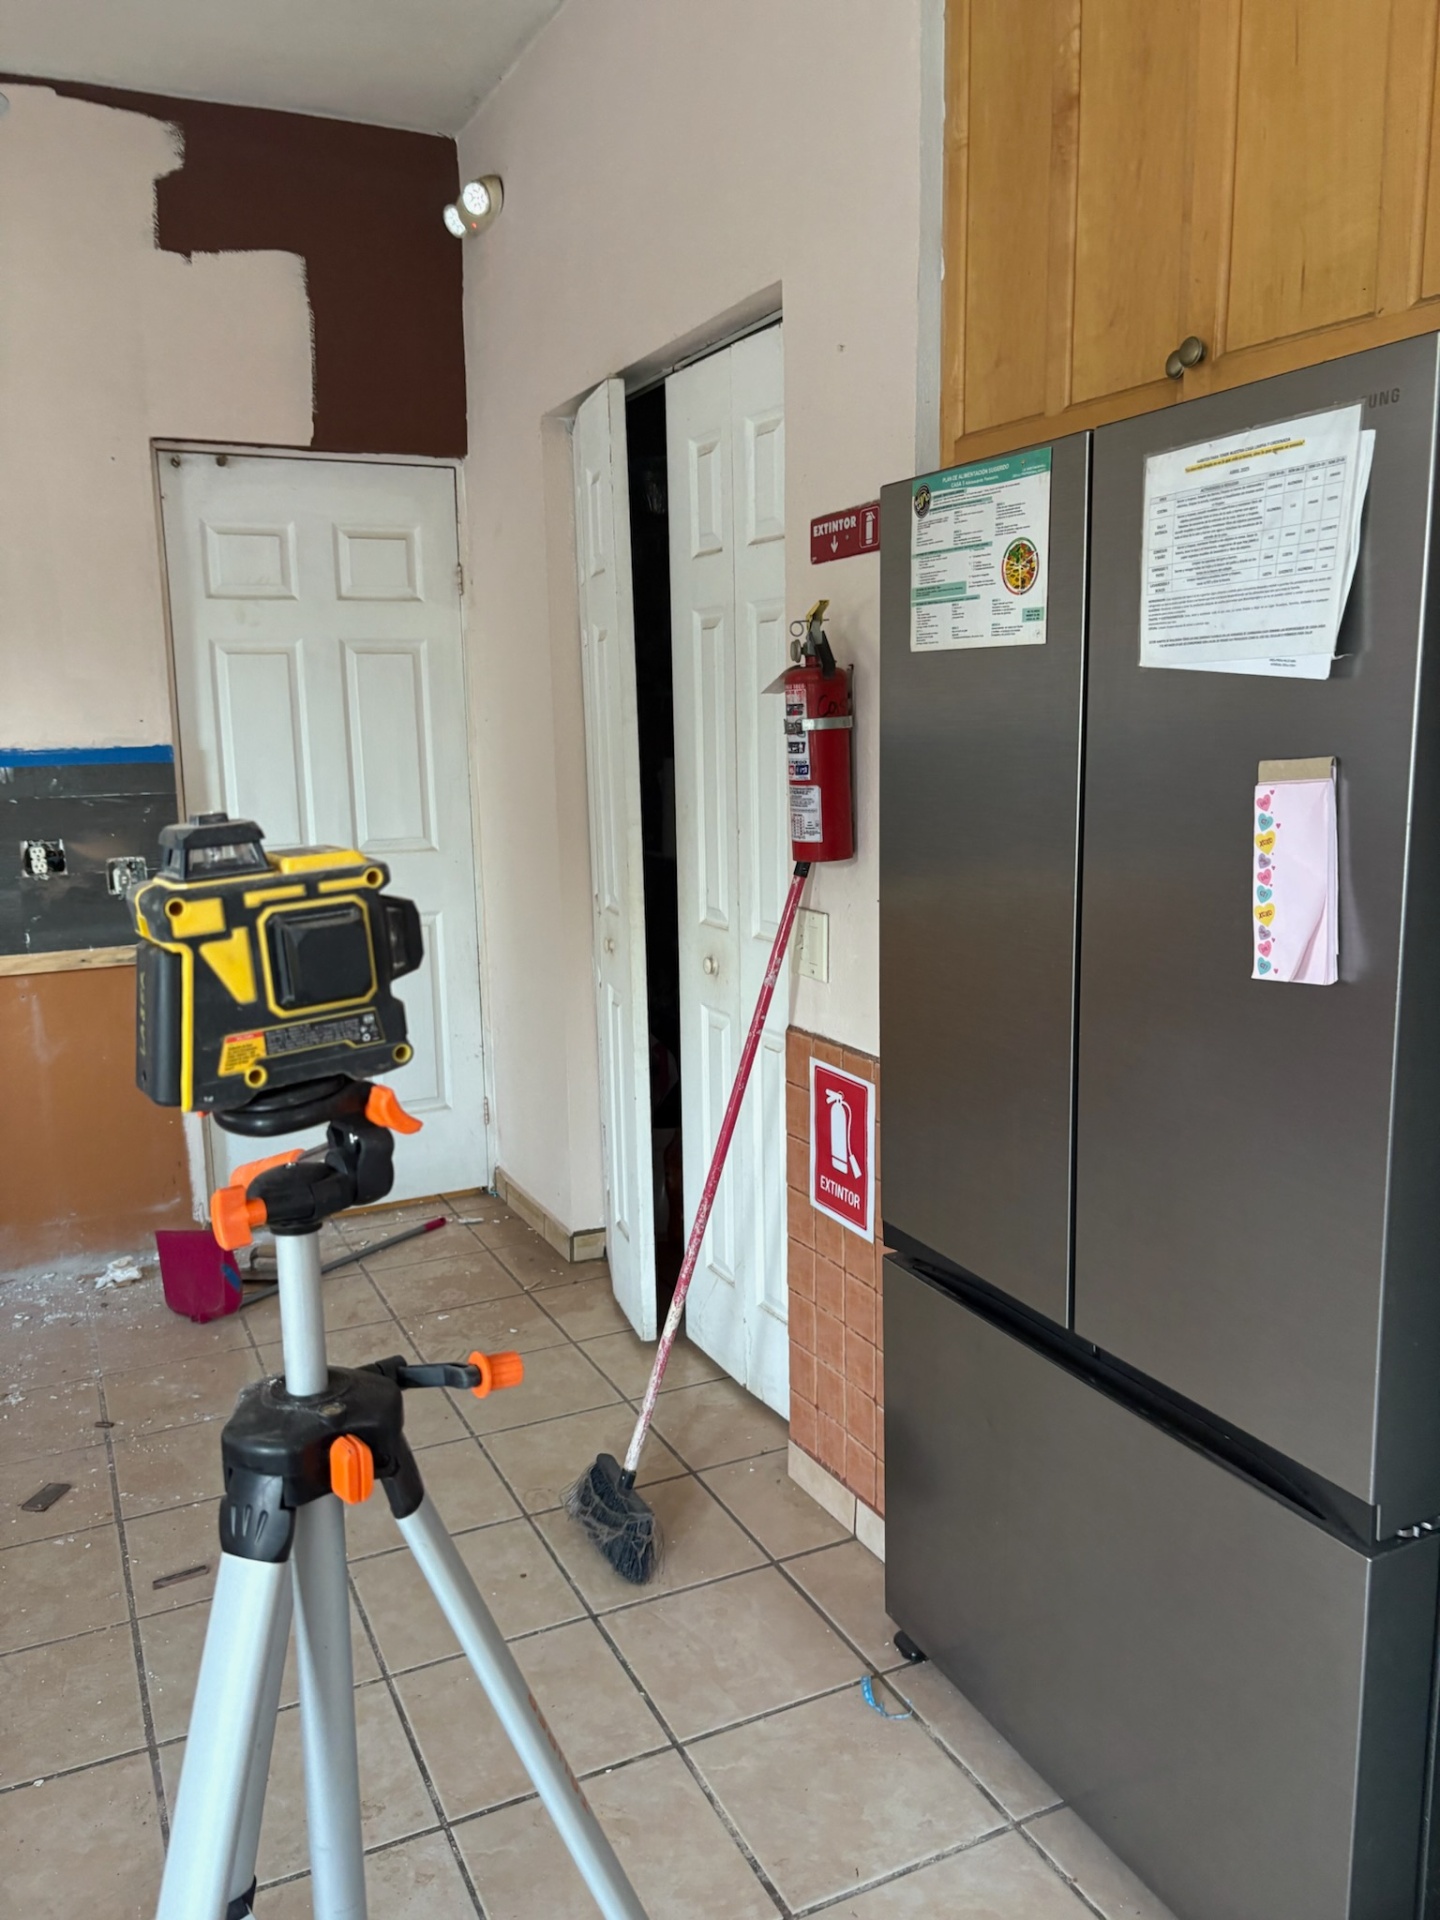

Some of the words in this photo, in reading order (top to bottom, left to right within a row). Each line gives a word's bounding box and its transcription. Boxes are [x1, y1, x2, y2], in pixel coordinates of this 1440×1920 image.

[813, 515, 857, 537] EXTINTOR
[1258, 909, 1273, 919] XOXO
[820, 1175, 861, 1210] EXTINTOR
